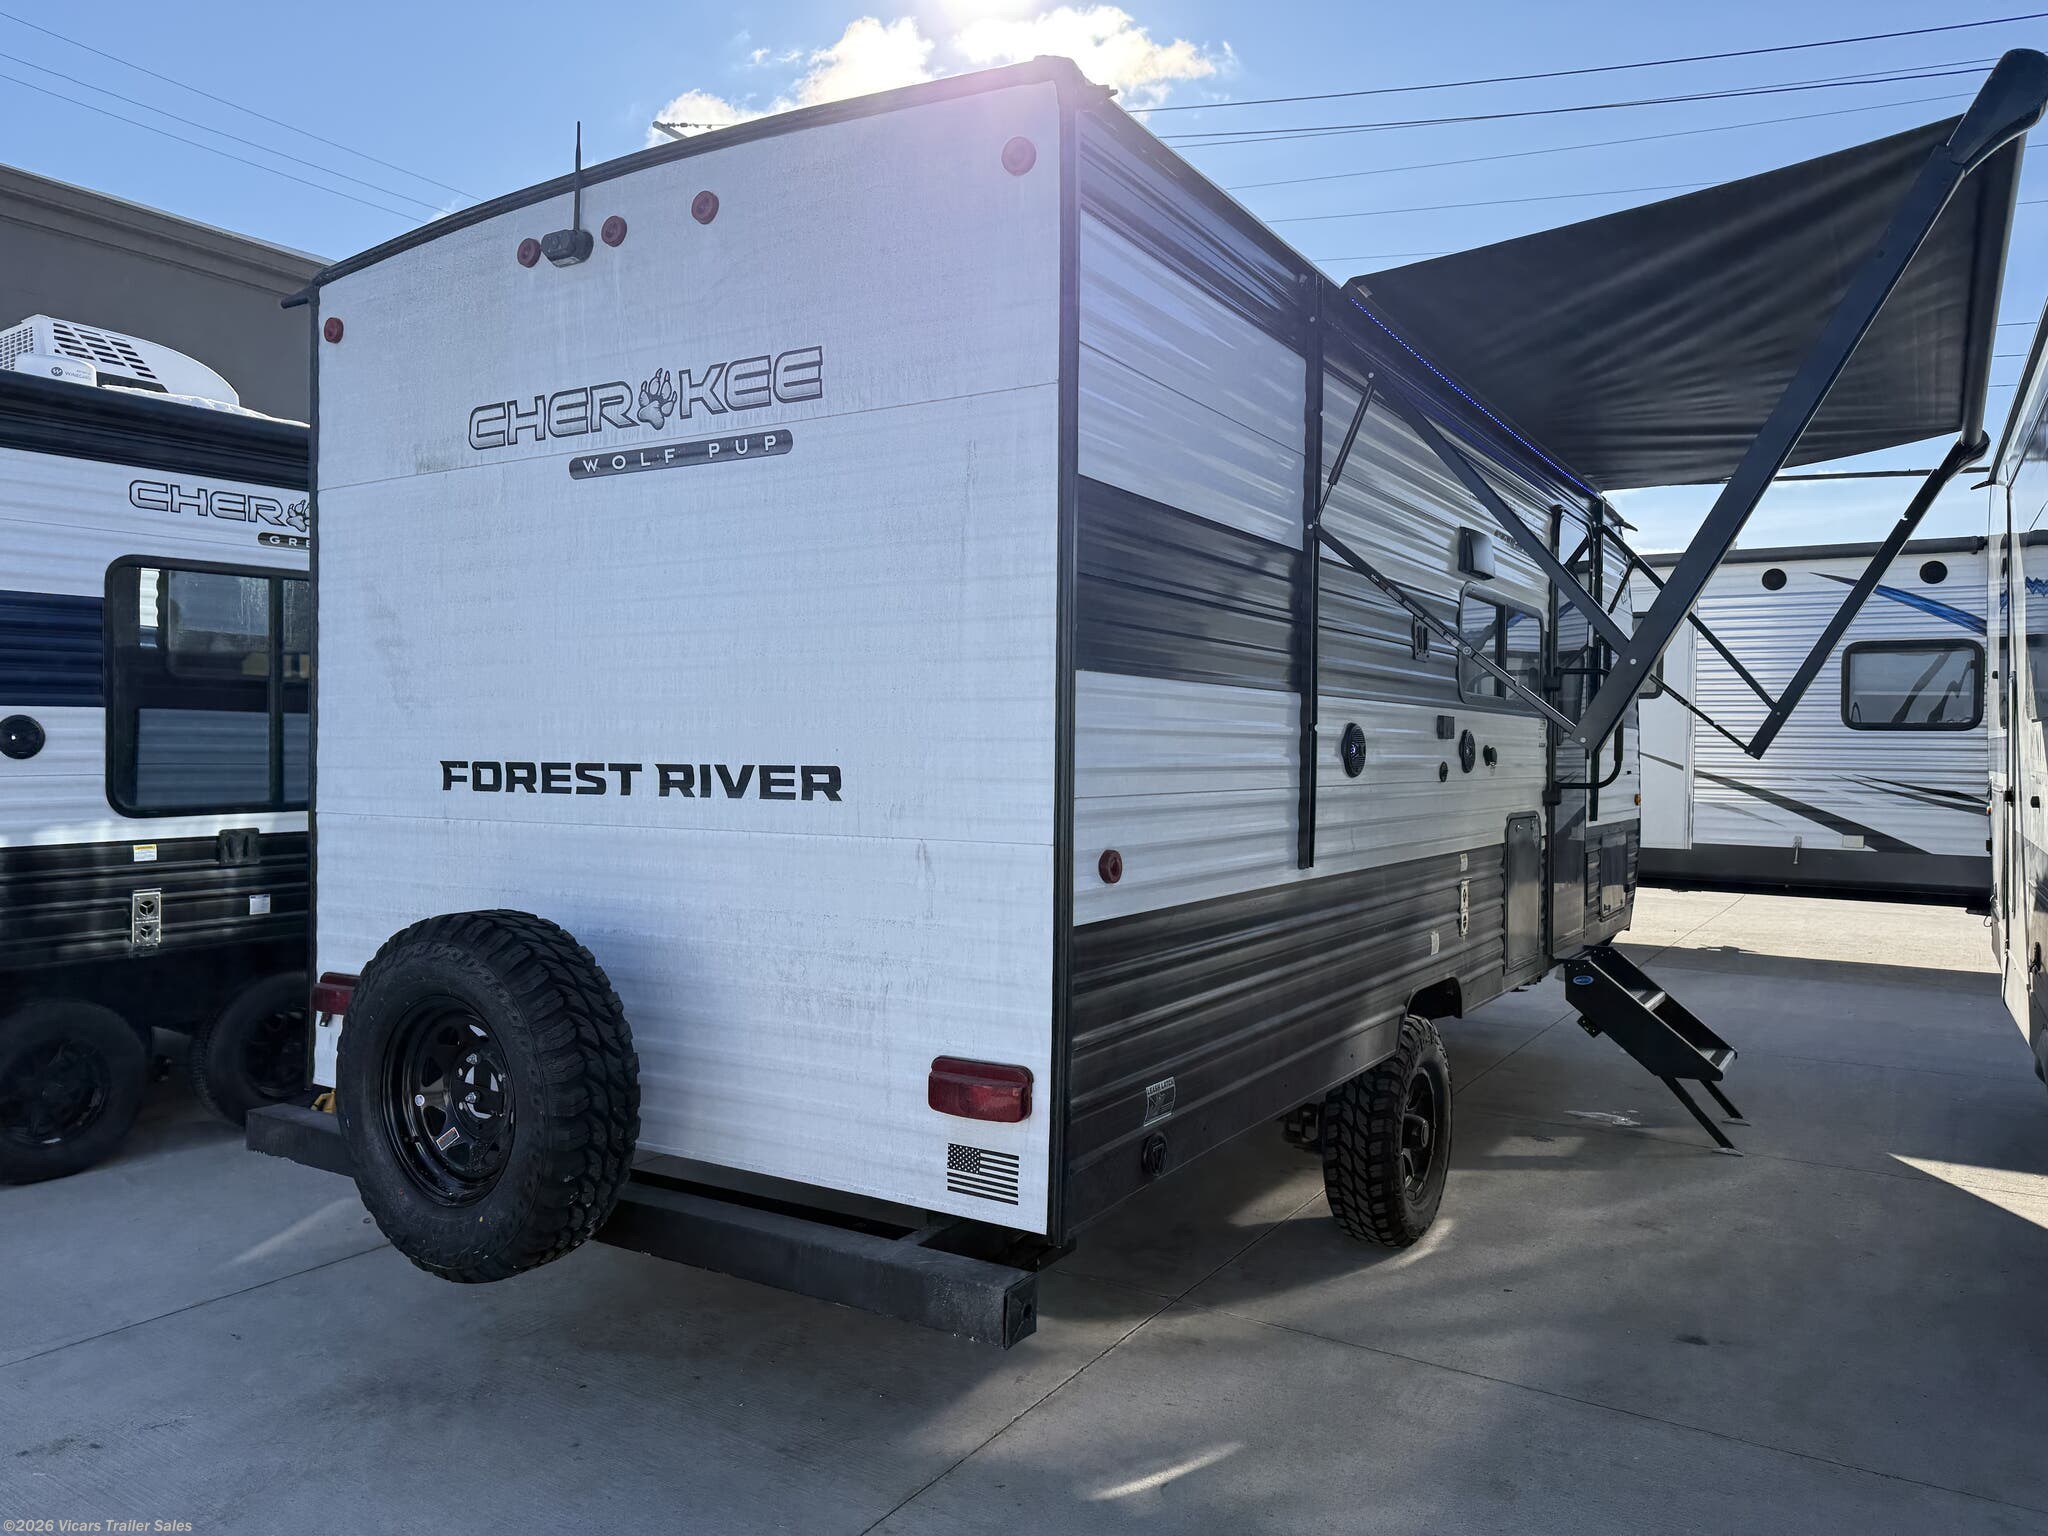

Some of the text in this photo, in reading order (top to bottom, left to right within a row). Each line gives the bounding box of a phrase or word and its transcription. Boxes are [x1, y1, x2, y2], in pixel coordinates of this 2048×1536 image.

[583, 435, 778, 474] WOLF PUP
[440, 760, 842, 802] FOREST RIVER
